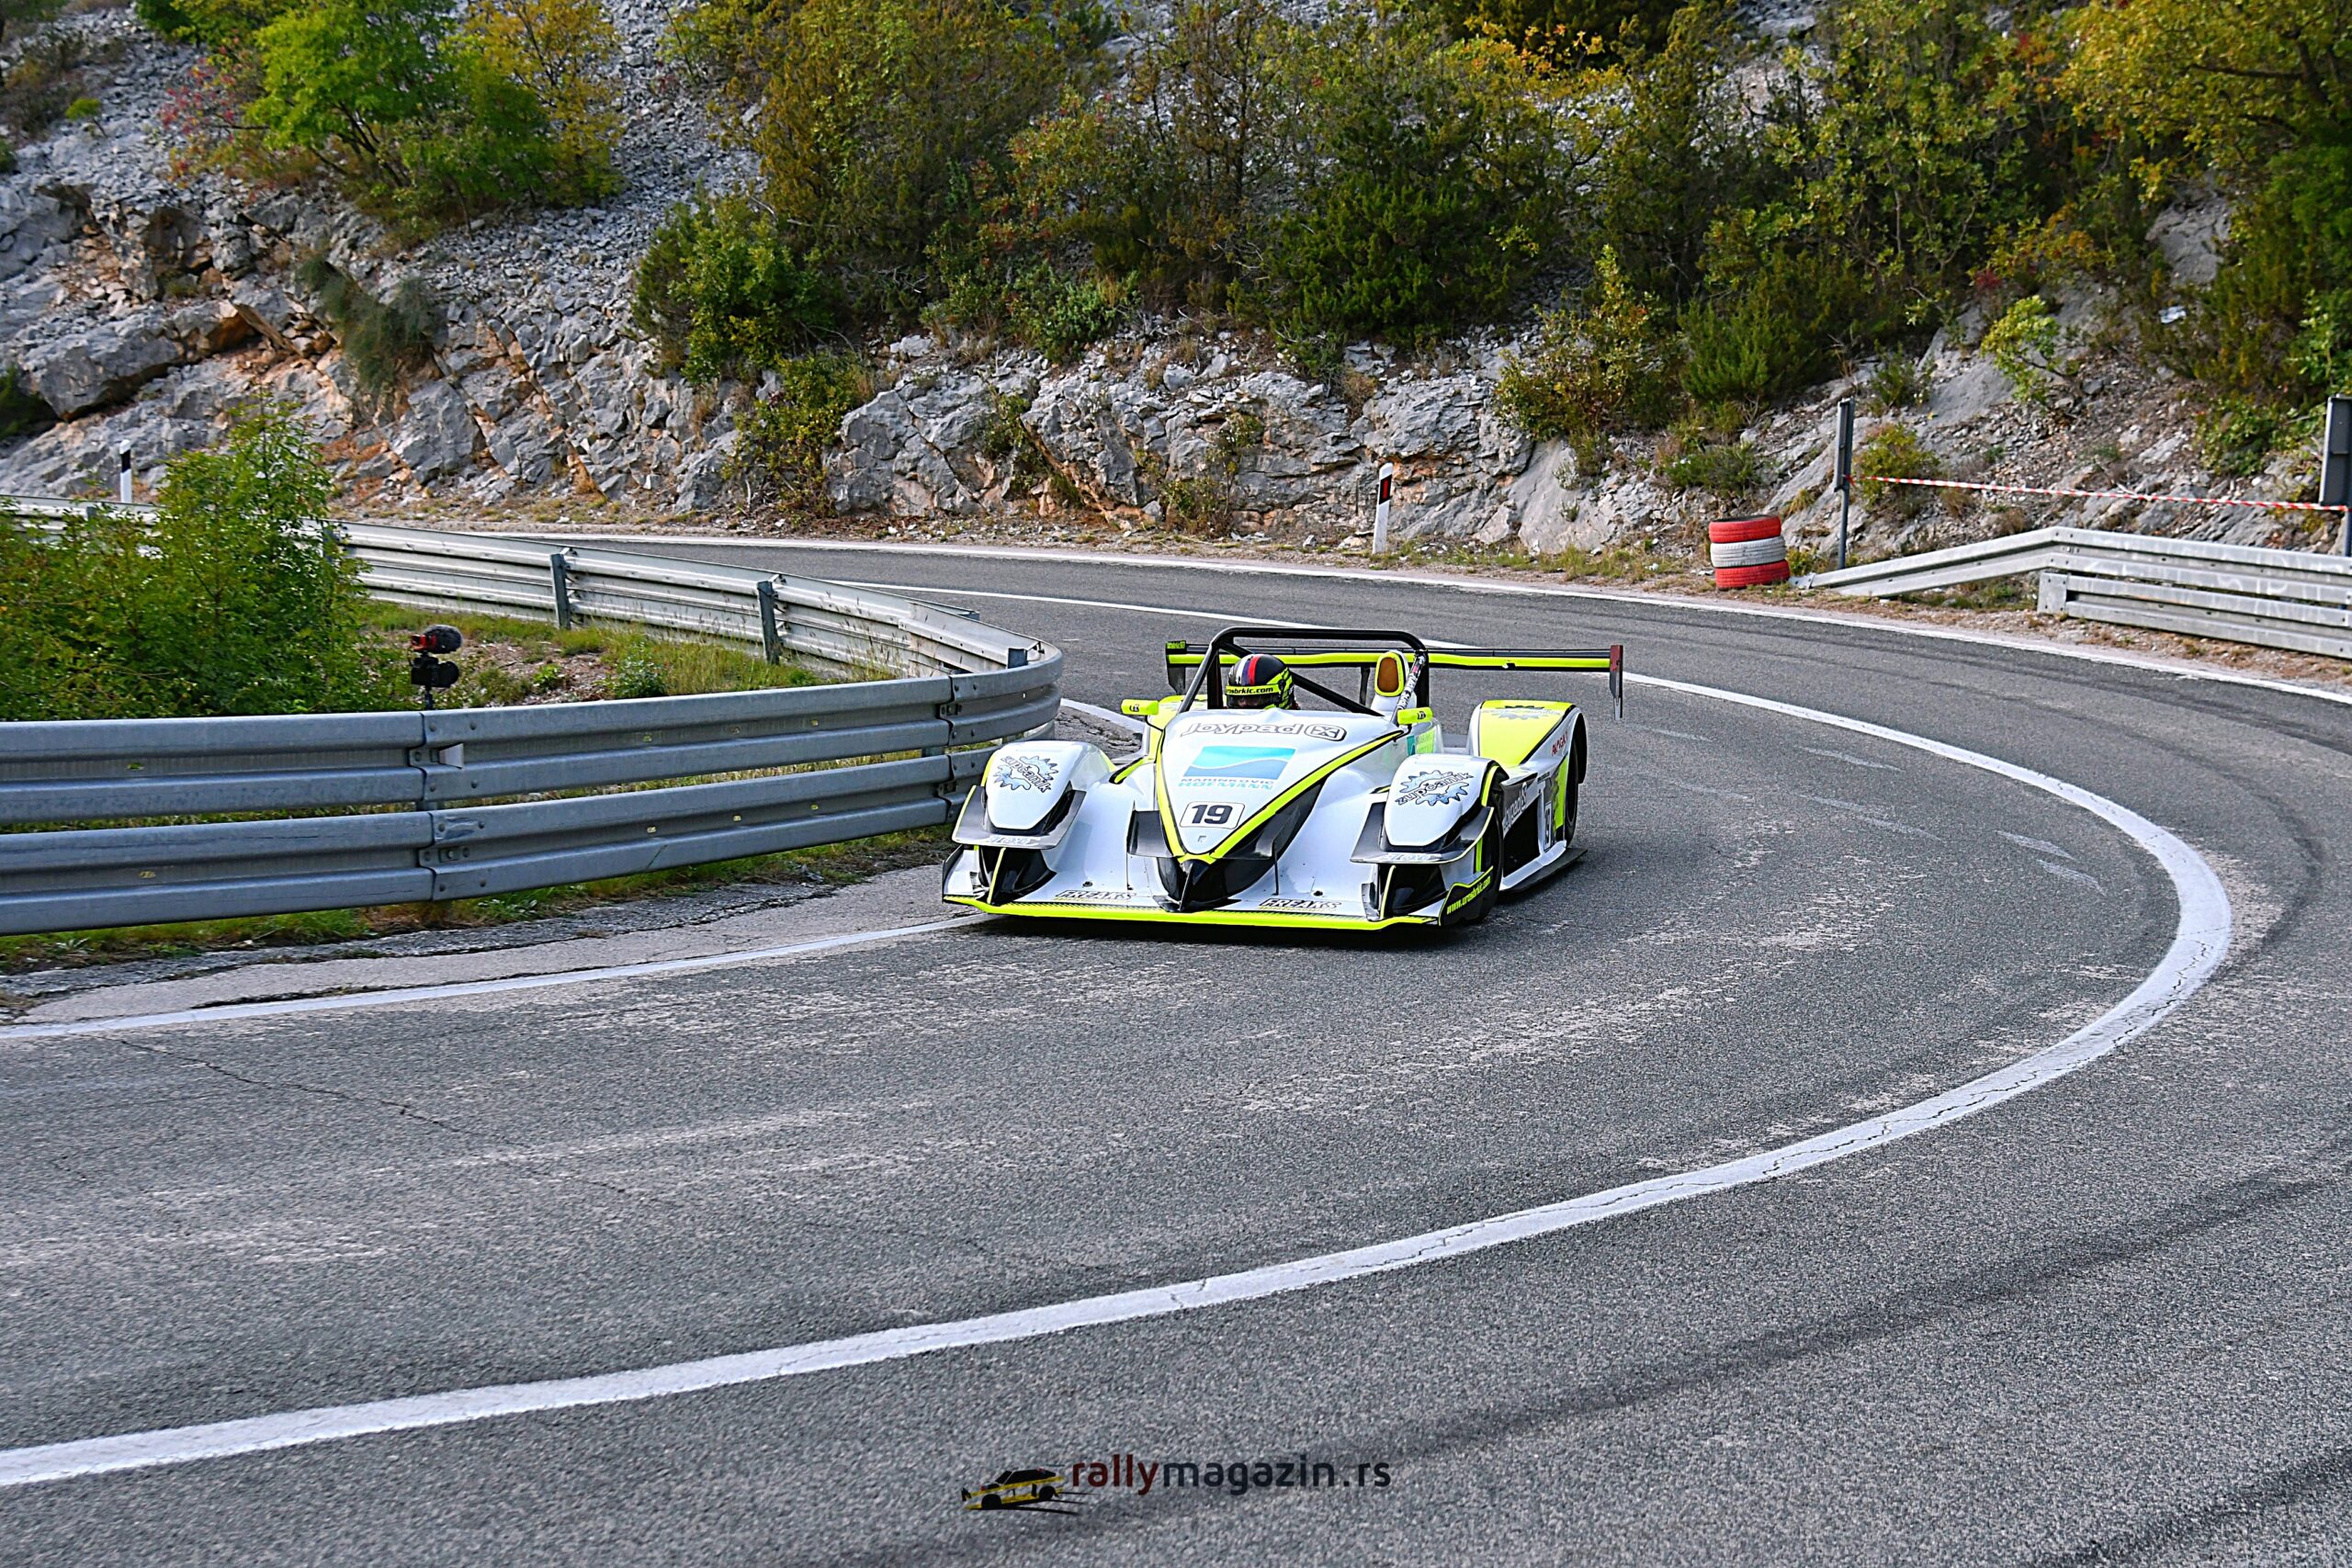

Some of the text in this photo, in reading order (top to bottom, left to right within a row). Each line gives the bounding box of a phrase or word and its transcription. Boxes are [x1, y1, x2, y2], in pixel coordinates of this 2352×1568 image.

[1191, 804, 1234, 825] 19
[1055, 889, 1136, 900] FREAKS
[1259, 897, 1342, 908] FREAKS
